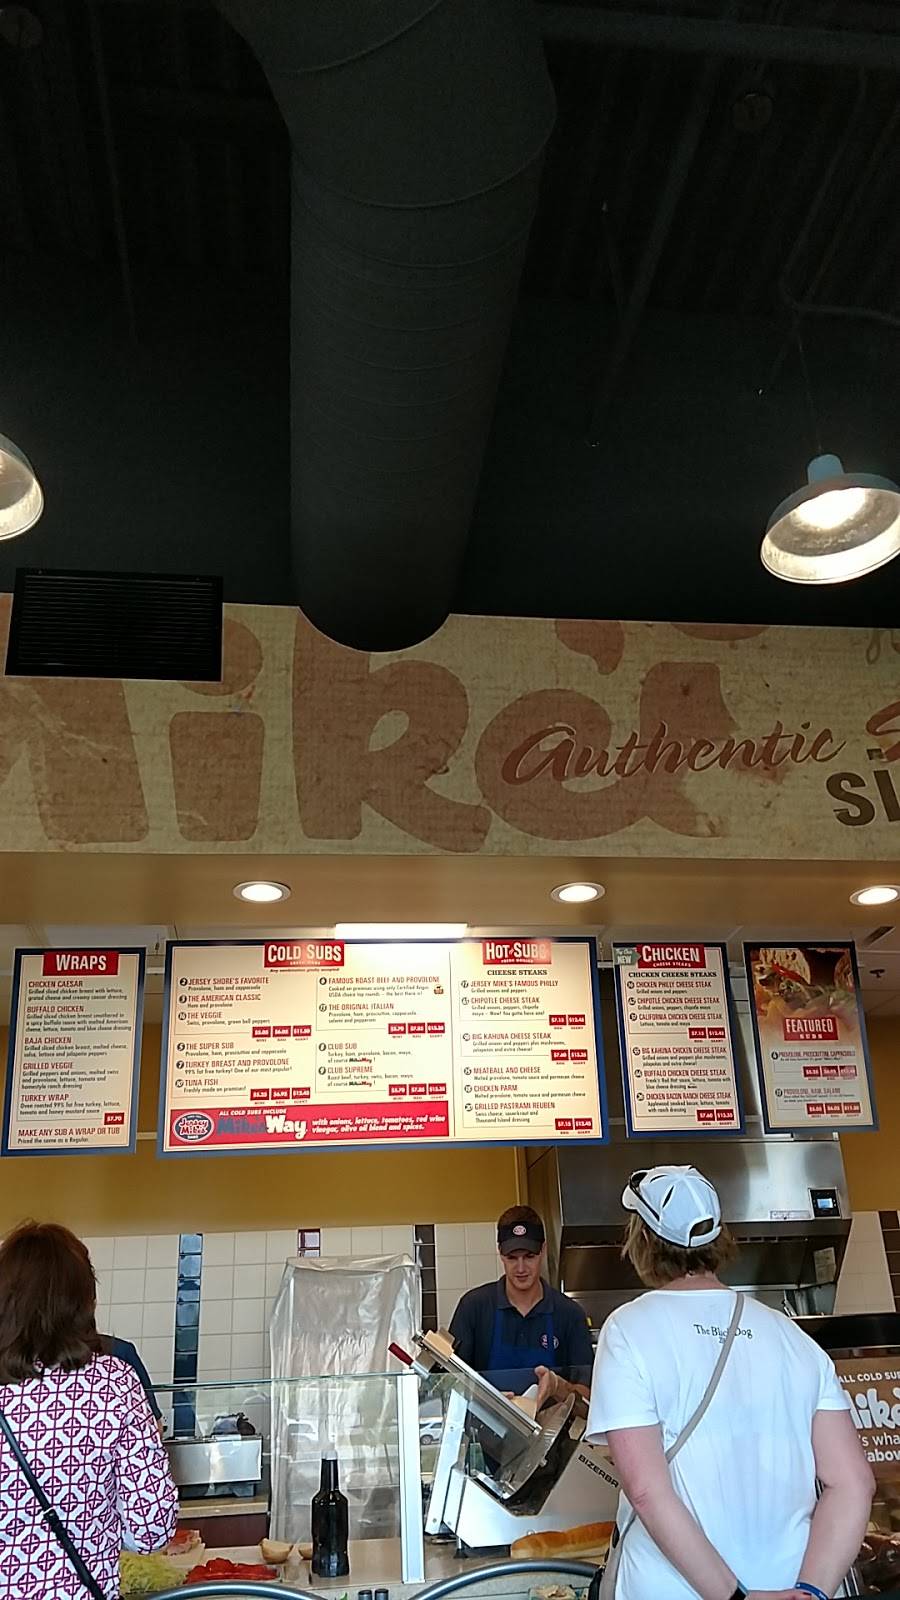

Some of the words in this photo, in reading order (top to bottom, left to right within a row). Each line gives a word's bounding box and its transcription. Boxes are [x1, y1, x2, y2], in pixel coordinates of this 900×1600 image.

[268, 945, 301, 962] COLD
[307, 944, 341, 961] SUBS
[486, 942, 510, 960] HOT
[642, 946, 700, 962] CHICKEN
[56, 954, 106, 971] WRAPS
[785, 1019, 834, 1033] FEATURED
[265, 1115, 307, 1140] Way
[693, 1324, 710, 1335] The
[734, 1327, 752, 1339] Dog
[839, 1374, 855, 1383] ALL
[857, 1373, 882, 1381] COLD
[578, 1454, 619, 1488] BIZERBA
